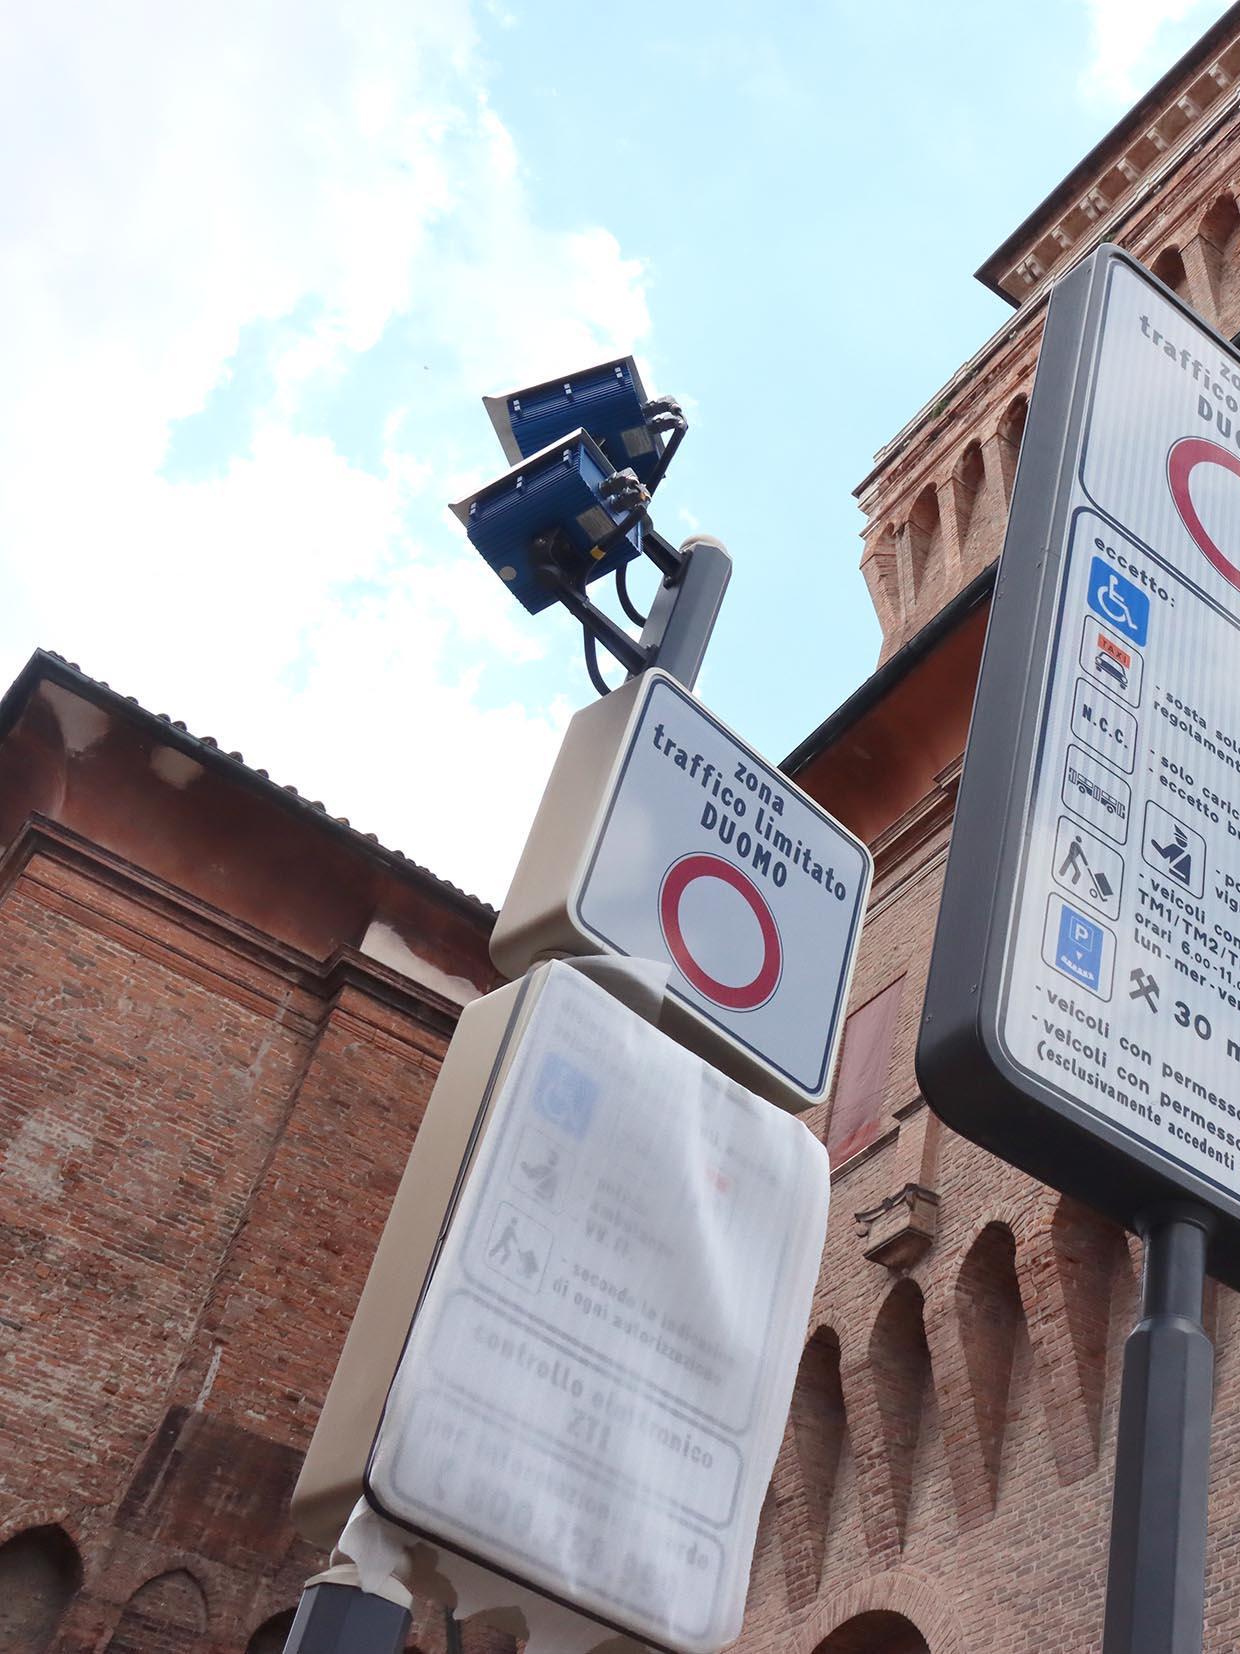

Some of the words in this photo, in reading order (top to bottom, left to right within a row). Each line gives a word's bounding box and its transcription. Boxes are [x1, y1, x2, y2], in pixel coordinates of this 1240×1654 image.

[1138, 314, 1239, 413] traffico
[1093, 537, 1176, 609] eccetto:
[1102, 640, 1127, 663] TAXI
[1081, 703, 1129, 750] N.C.C.
[1165, 691, 1207, 730] sosta
[733, 761, 785, 817] zona
[1160, 755, 1195, 787] solo
[652, 723, 747, 818] traffico
[754, 806, 847, 902] limitato
[1159, 774, 1220, 824] eccetto
[699, 800, 788, 889] DUOMO
[1149, 877, 1206, 926] veicoli
[1074, 923, 1089, 941] P
[1134, 911, 1173, 945] orari
[1046, 988, 1110, 1040] veicoli
[1119, 1036, 1152, 1067] con
[1173, 1000, 1213, 1041] 30
[1042, 1018, 1108, 1069] veicoli
[1116, 1065, 1150, 1096] con
[1036, 1039, 1162, 1127] (esclusivamente
[1167, 1121, 1235, 1172] accedenti
